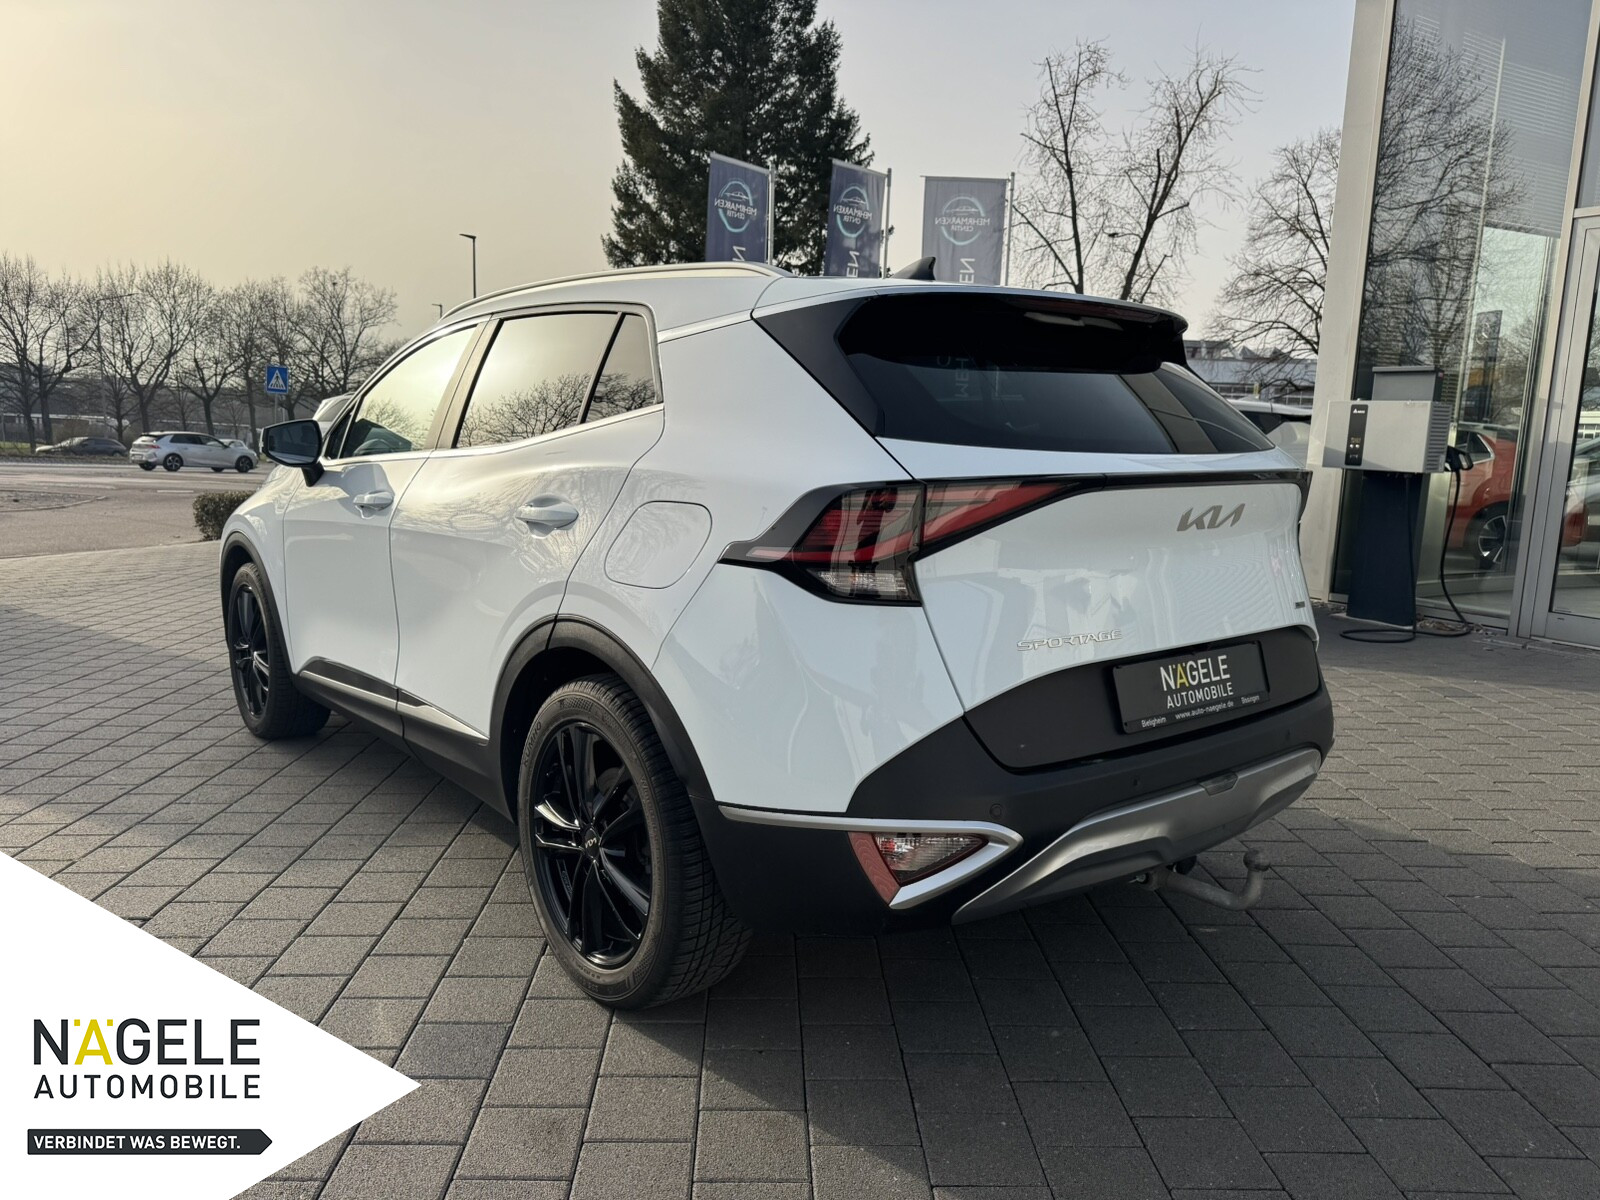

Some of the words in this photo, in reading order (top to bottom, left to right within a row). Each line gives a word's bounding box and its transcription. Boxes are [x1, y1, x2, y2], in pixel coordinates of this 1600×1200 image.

[1177, 503, 1245, 532] KIA
[1016, 629, 1123, 651] SPORTAGE
[1160, 655, 1230, 691] NÄGELE
[1167, 682, 1234, 709] AUTOMOBILE
[1175, 700, 1234, 720] www.auto-naegele.de
